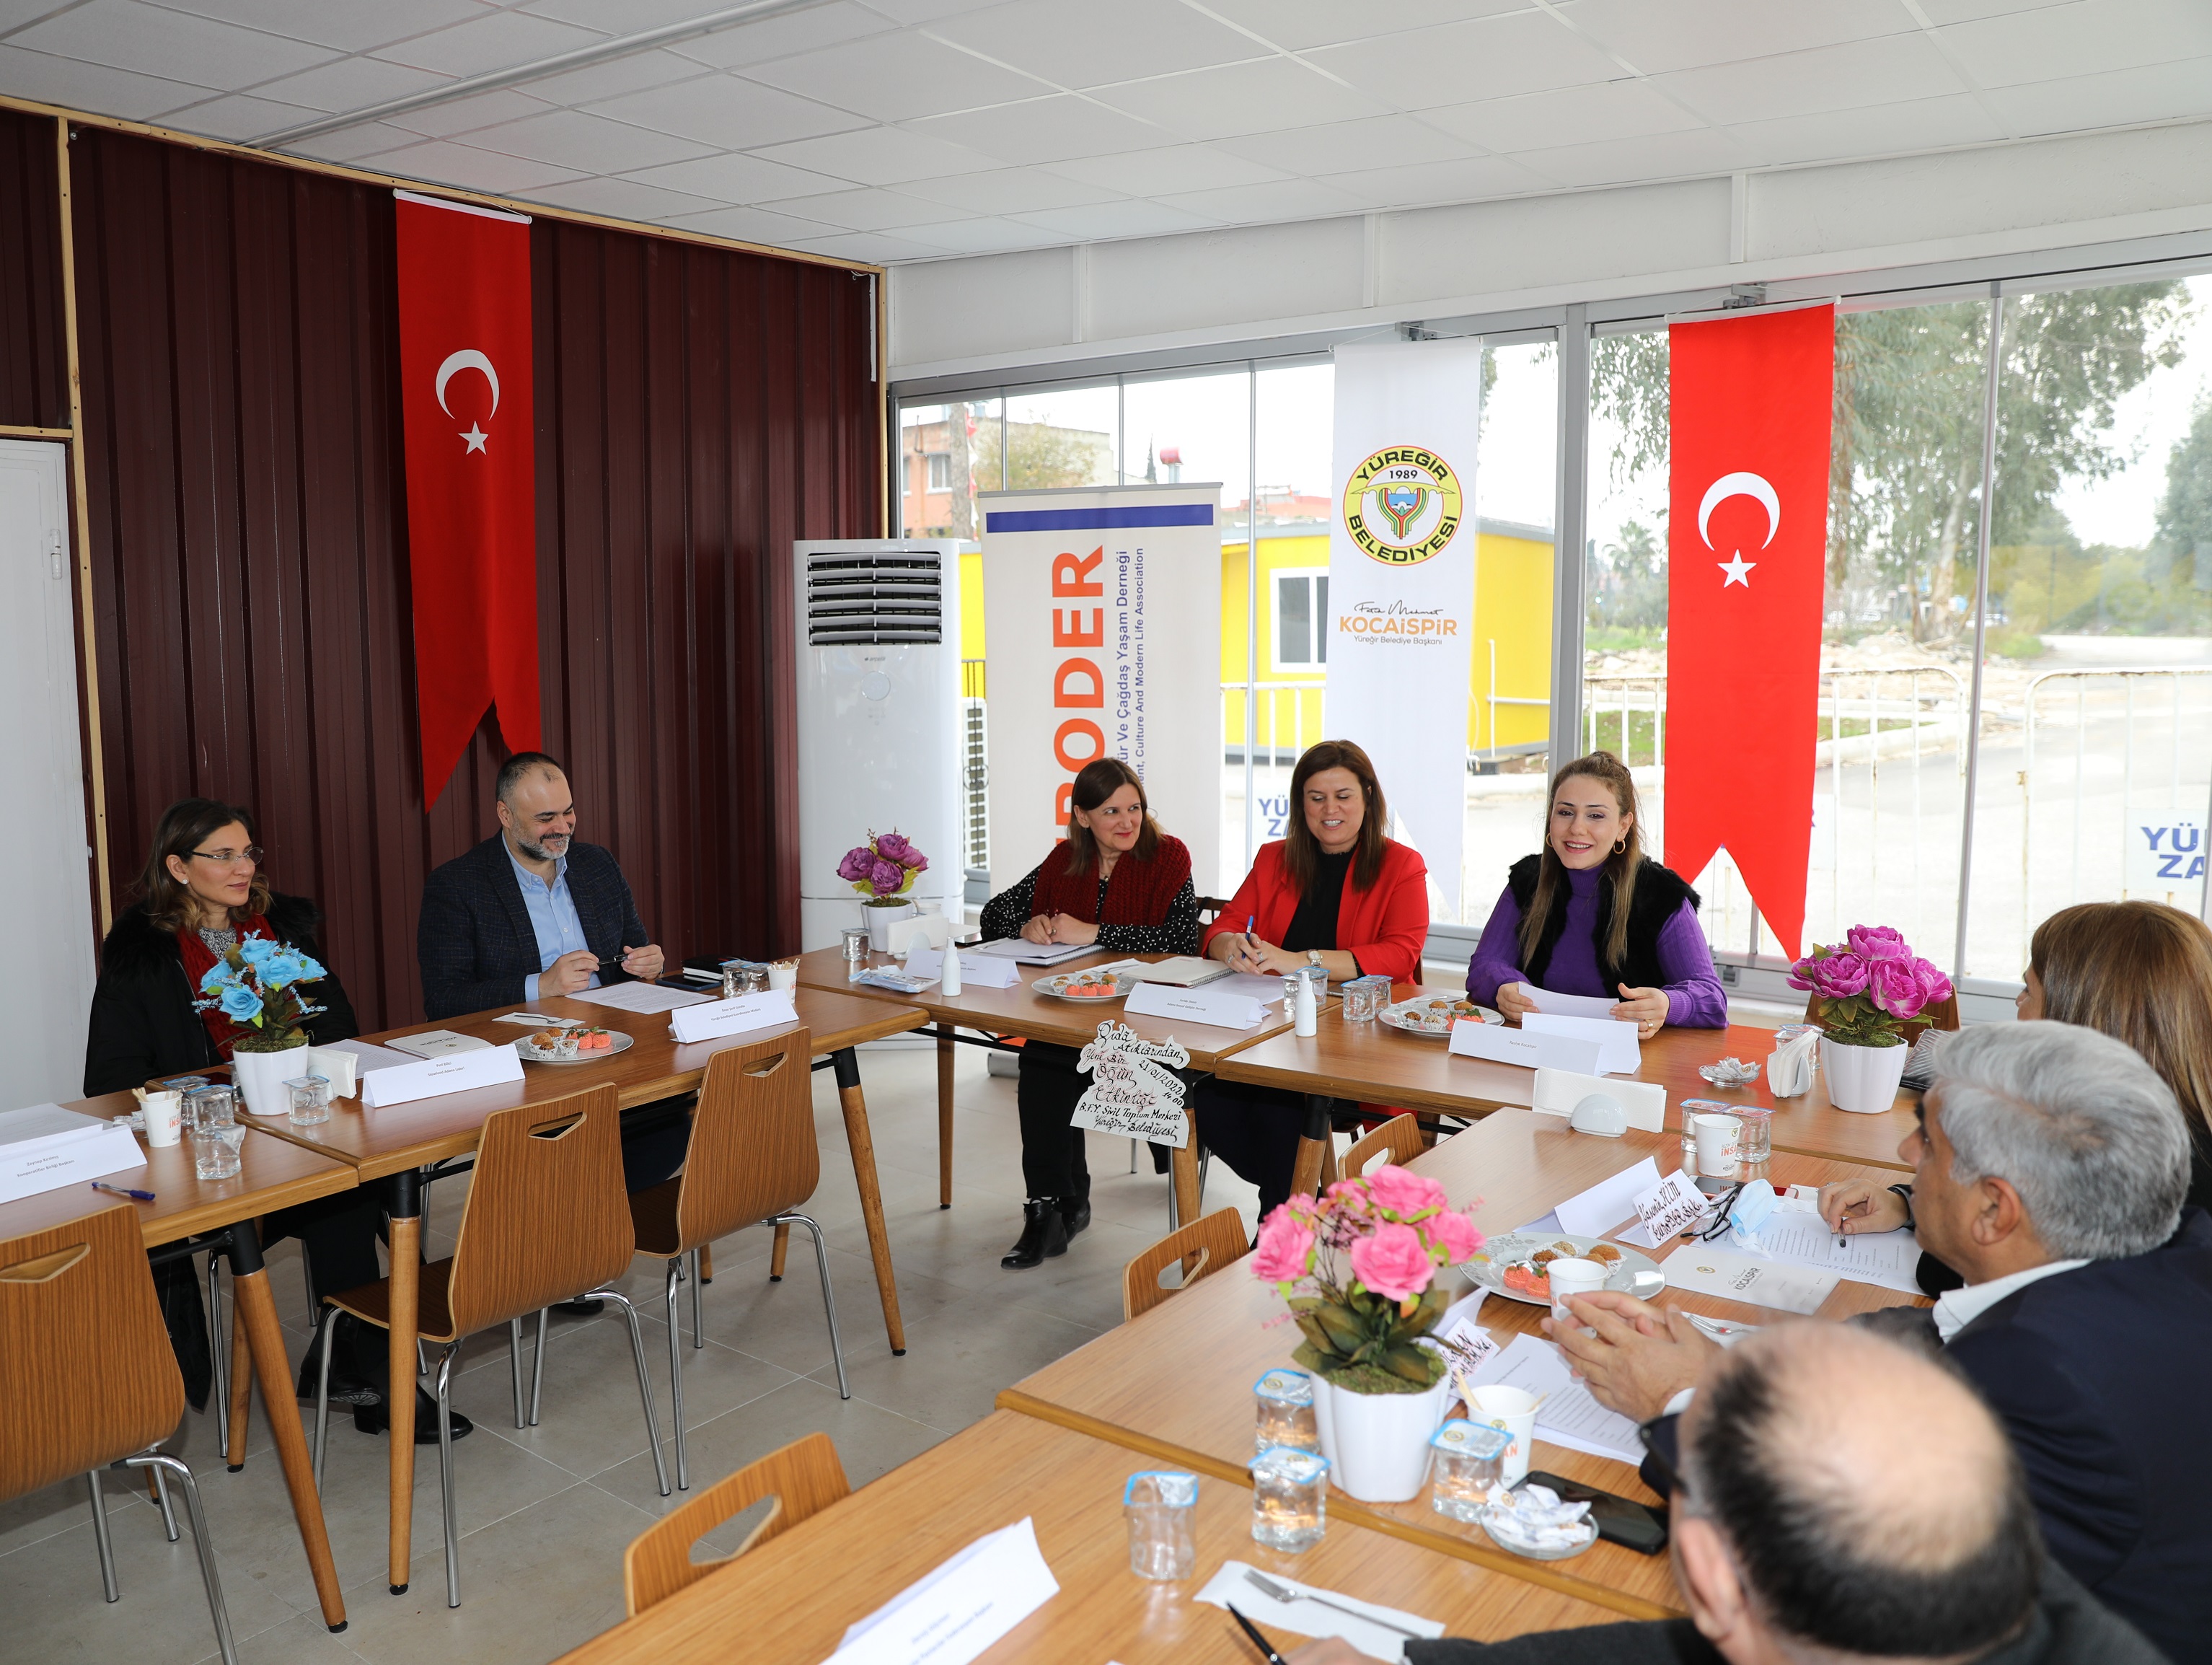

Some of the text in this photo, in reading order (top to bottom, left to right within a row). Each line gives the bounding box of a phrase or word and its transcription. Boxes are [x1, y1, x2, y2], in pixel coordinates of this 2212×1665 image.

[1356, 449, 1449, 482] YÜREĞİR
[1389, 470, 1418, 480] 1989
[1348, 514, 1458, 562] BELEDİYESİ
[1116, 550, 1131, 764] ür Ve Çağdaş Yaşam Derneği
[1380, 636, 1412, 646] Belediye
[1413, 637, 1442, 646] Başkanı
[1134, 548, 1145, 784] ent, Culture And Modern Life Association
[1052, 545, 1105, 846] ODER
[2140, 822, 2207, 853] YÜ
[1138, 1060, 1184, 1095] 21/01/2022
[1102, 1107, 1120, 1117] Sivil
[1150, 1108, 1182, 1120] Merkezi
